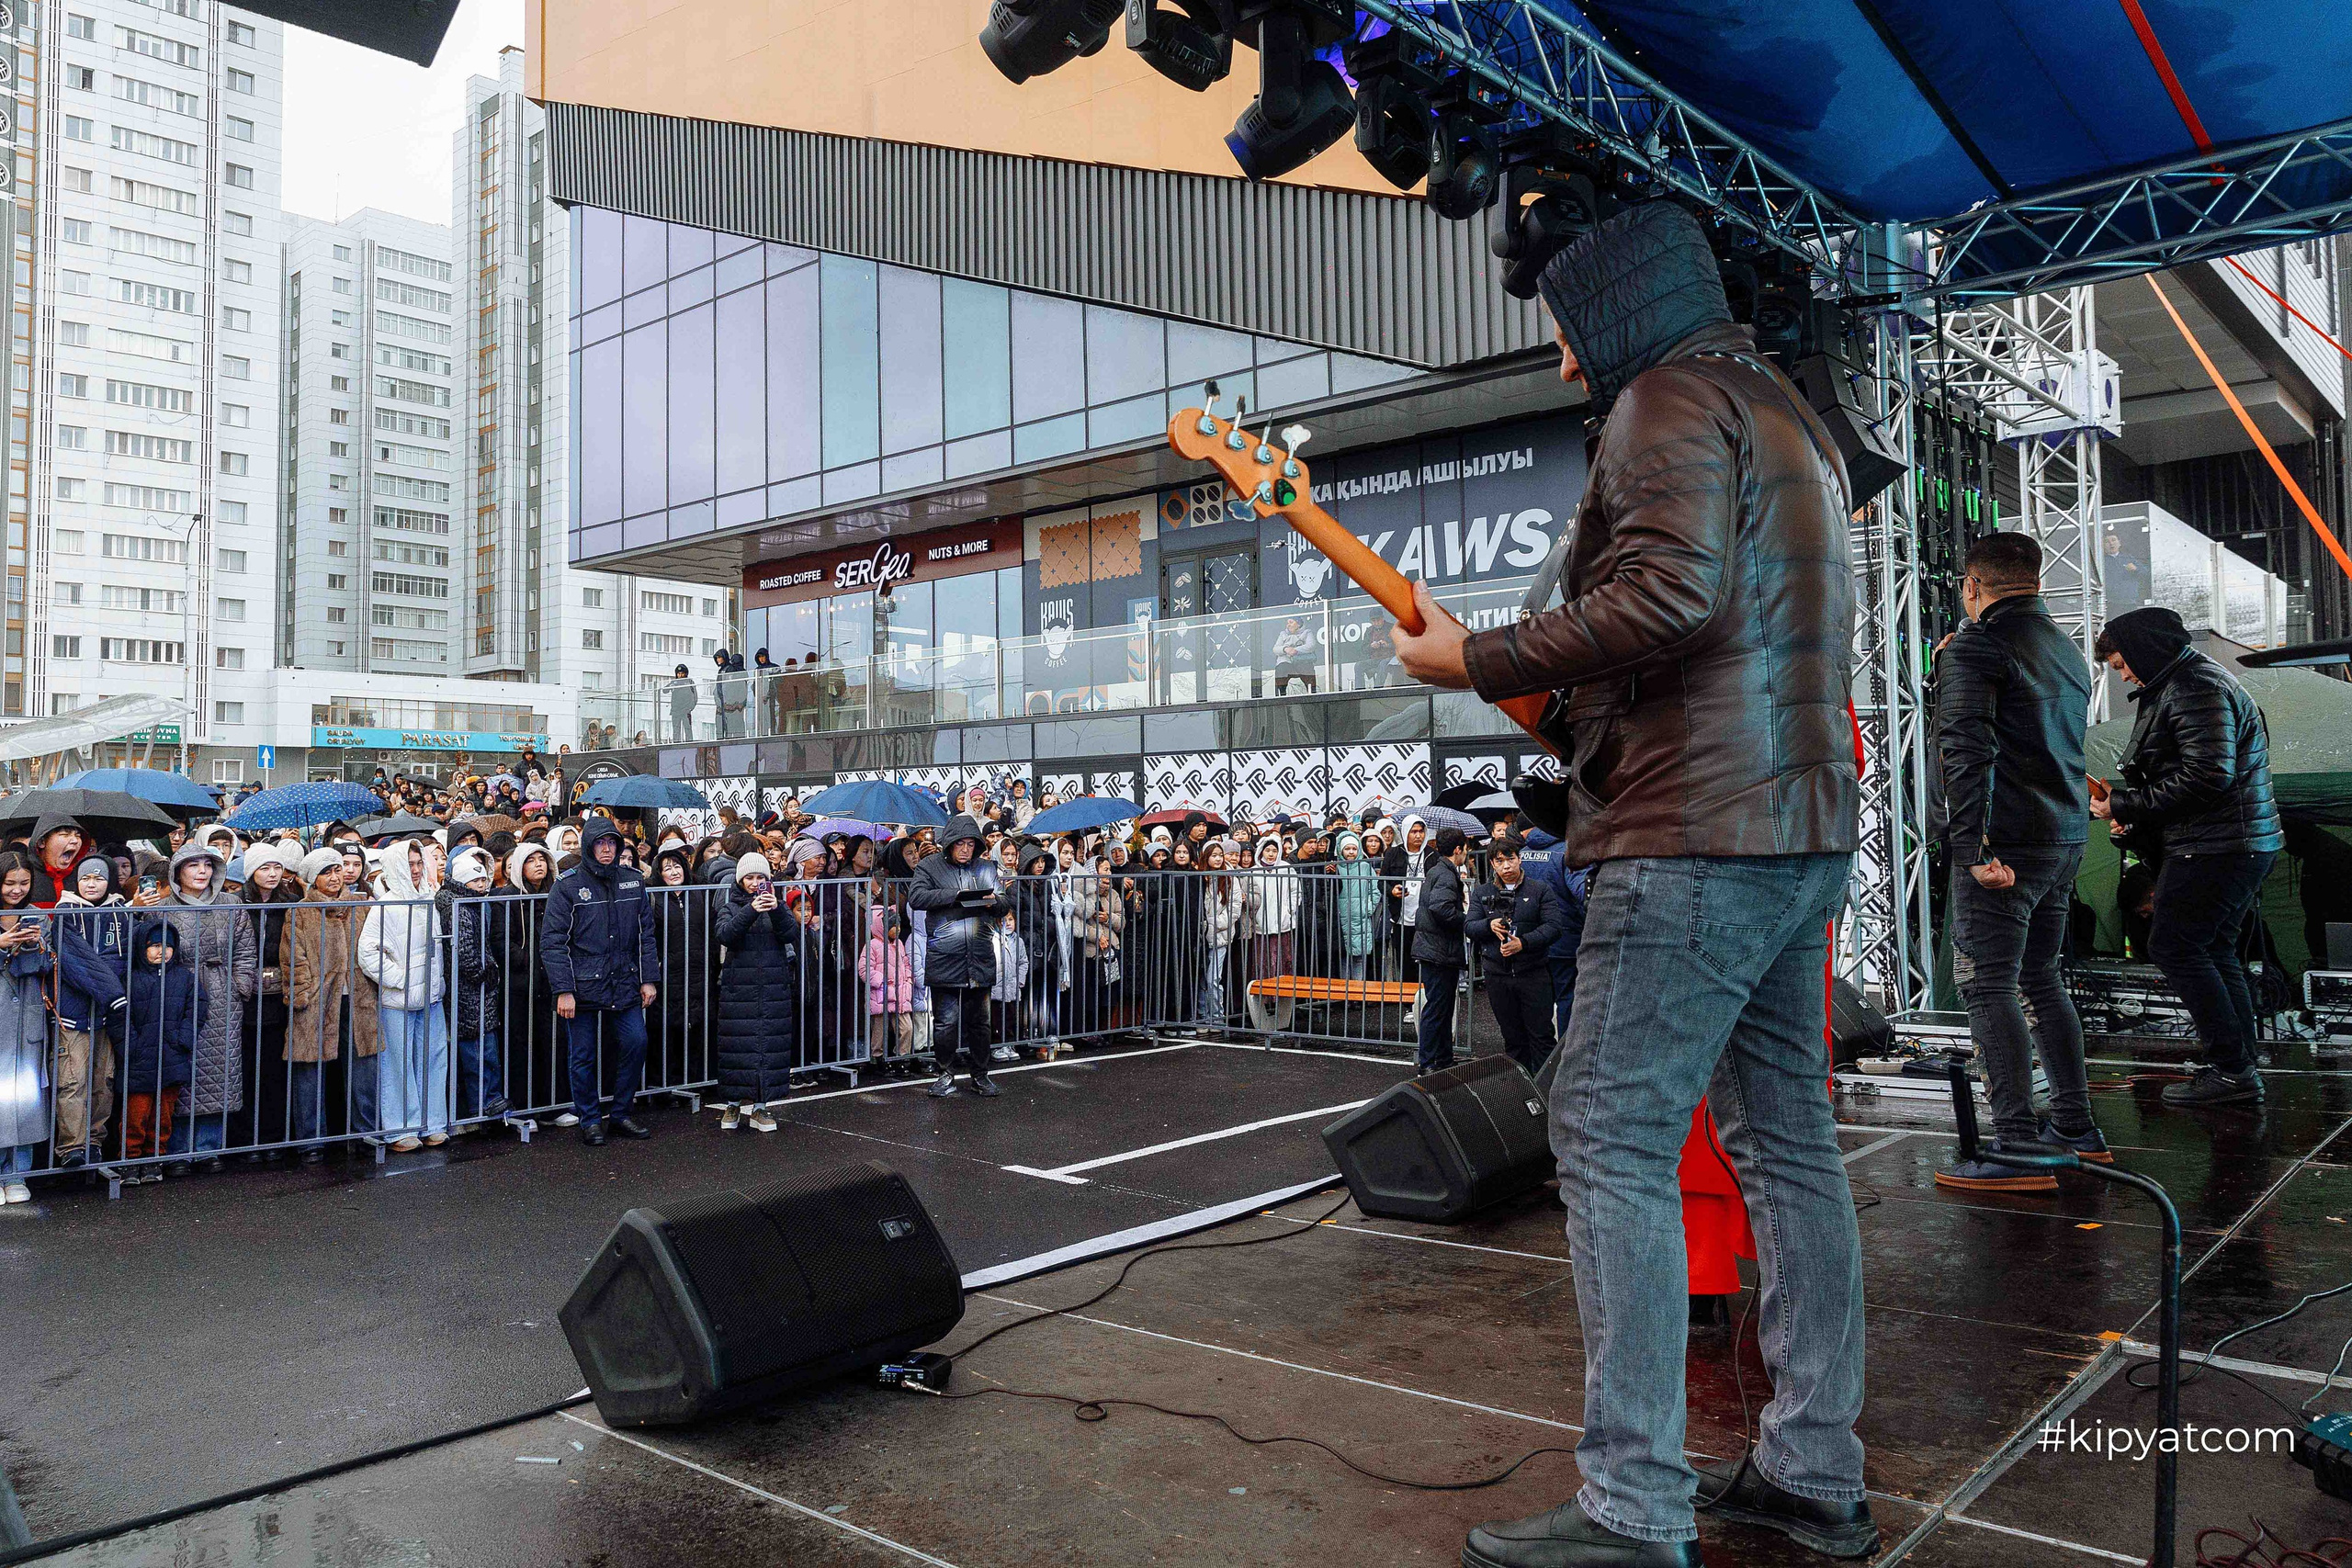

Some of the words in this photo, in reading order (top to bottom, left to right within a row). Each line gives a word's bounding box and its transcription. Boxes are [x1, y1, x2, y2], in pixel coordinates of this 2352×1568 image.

[1416, 447, 1533, 486] АШЫЛУЫ
[928, 546, 953, 560] NUTS
[954, 545, 961, 556] &
[962, 539, 989, 555] MORE
[1348, 508, 1554, 590] KAWS
[760, 573, 793, 591] ROASTED
[793, 569, 822, 584] COFFEE
[1044, 655, 1068, 669] COFFEE
[401, 732, 471, 748] PARASAT
[1521, 852, 1549, 861] POLISIA
